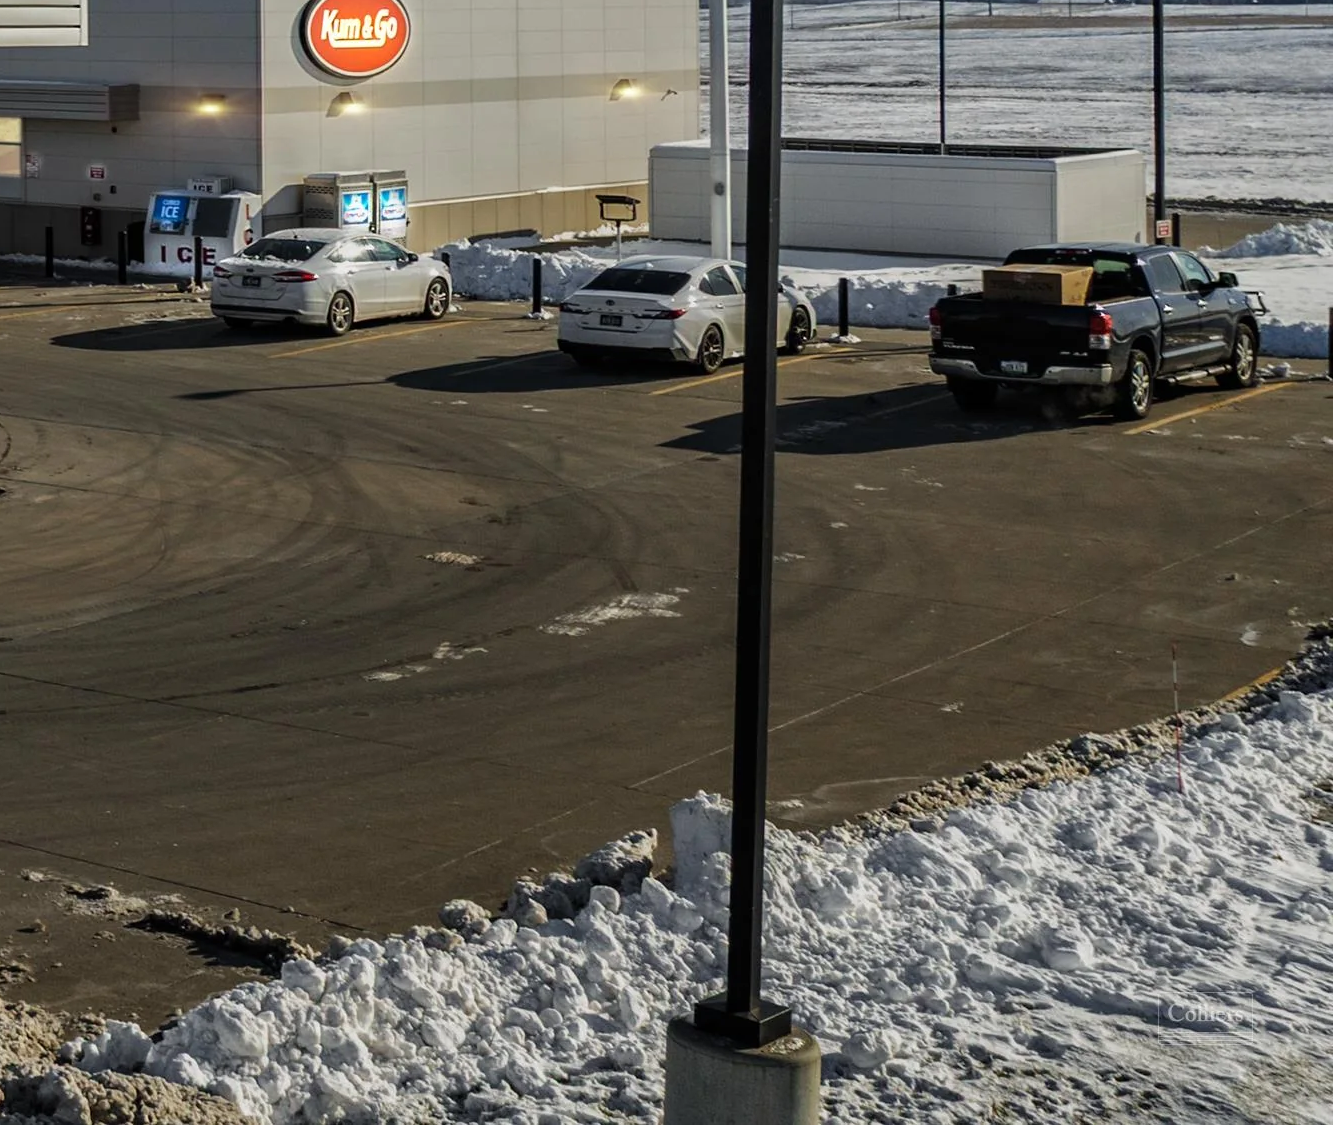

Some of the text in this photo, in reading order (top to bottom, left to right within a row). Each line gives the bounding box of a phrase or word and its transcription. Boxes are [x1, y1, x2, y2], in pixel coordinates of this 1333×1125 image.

[320, 8, 398, 48] Kum & Go
[193, 184, 214, 194] ICE
[160, 205, 181, 218] ICE
[160, 245, 217, 266] ICE
